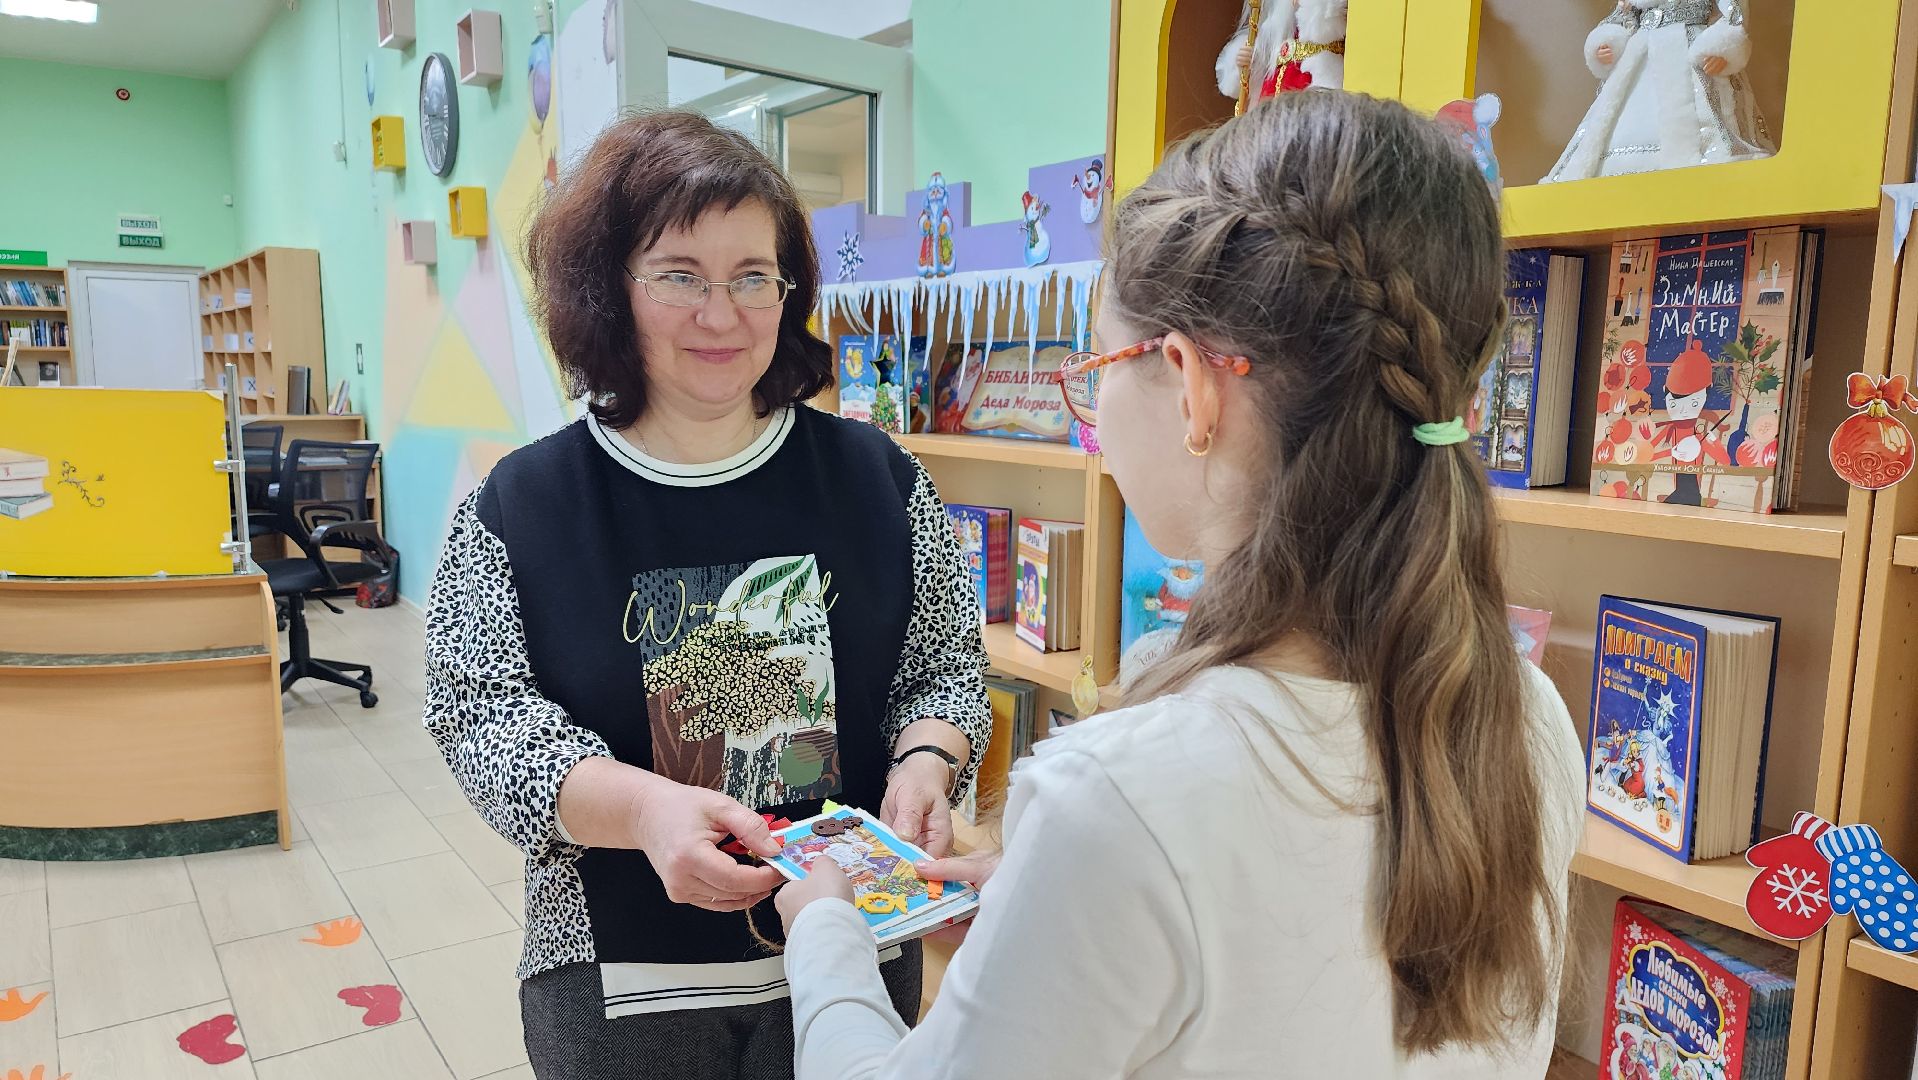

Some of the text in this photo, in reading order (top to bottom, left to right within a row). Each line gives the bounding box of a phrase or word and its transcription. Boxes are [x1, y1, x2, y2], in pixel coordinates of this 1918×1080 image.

[122, 235, 161, 247] ВЫХОД
[980, 396, 1062, 413] Деда Мороза
[622, 570, 840, 646] Wonderful
[778, 623, 828, 638] ABOUT
[719, 633, 817, 654] EVERYTHING
[1605, 624, 1692, 684] ПОИГРАЕМ
[1634, 661, 1668, 686] сказку
[1647, 946, 1707, 1010] Любимые
[1630, 976, 1721, 1060] ДЕДОВ МОРОЗОВ
